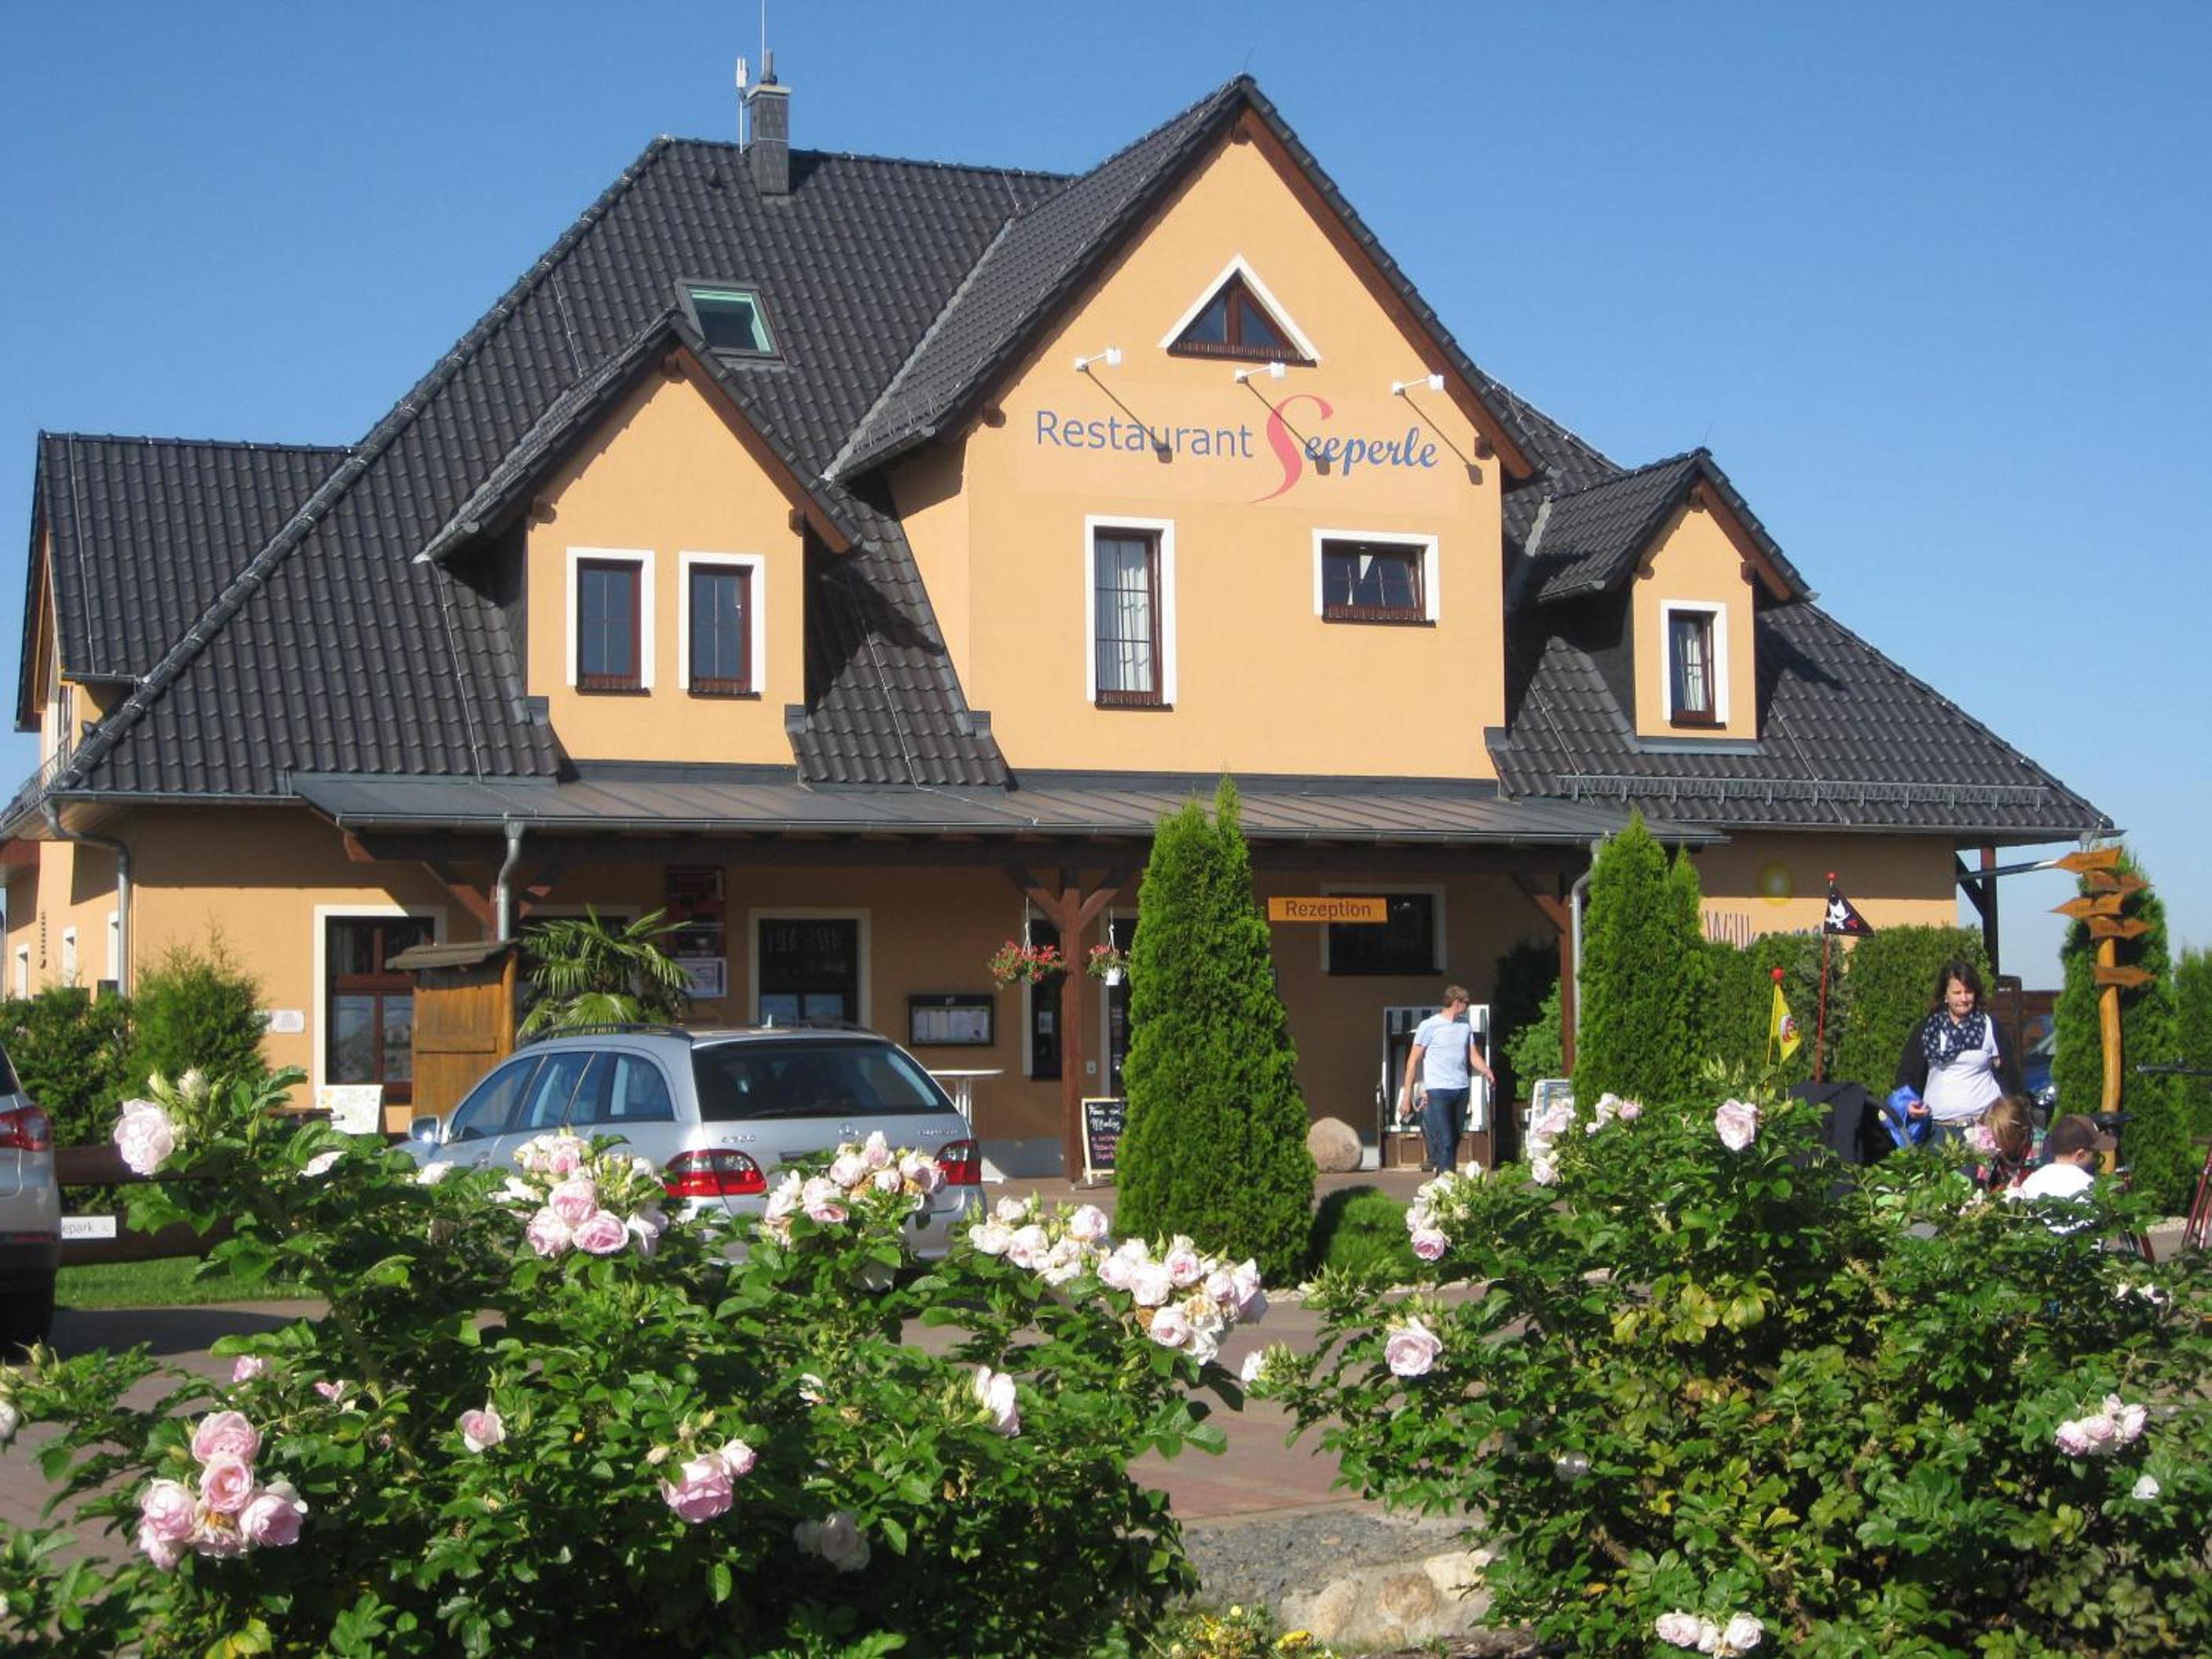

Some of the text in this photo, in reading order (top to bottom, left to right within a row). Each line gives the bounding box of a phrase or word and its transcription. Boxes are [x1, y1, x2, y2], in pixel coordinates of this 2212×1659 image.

[1035, 394, 1439, 504] Restaurant Seeperle
[1284, 899, 1372, 920] Rezeption
